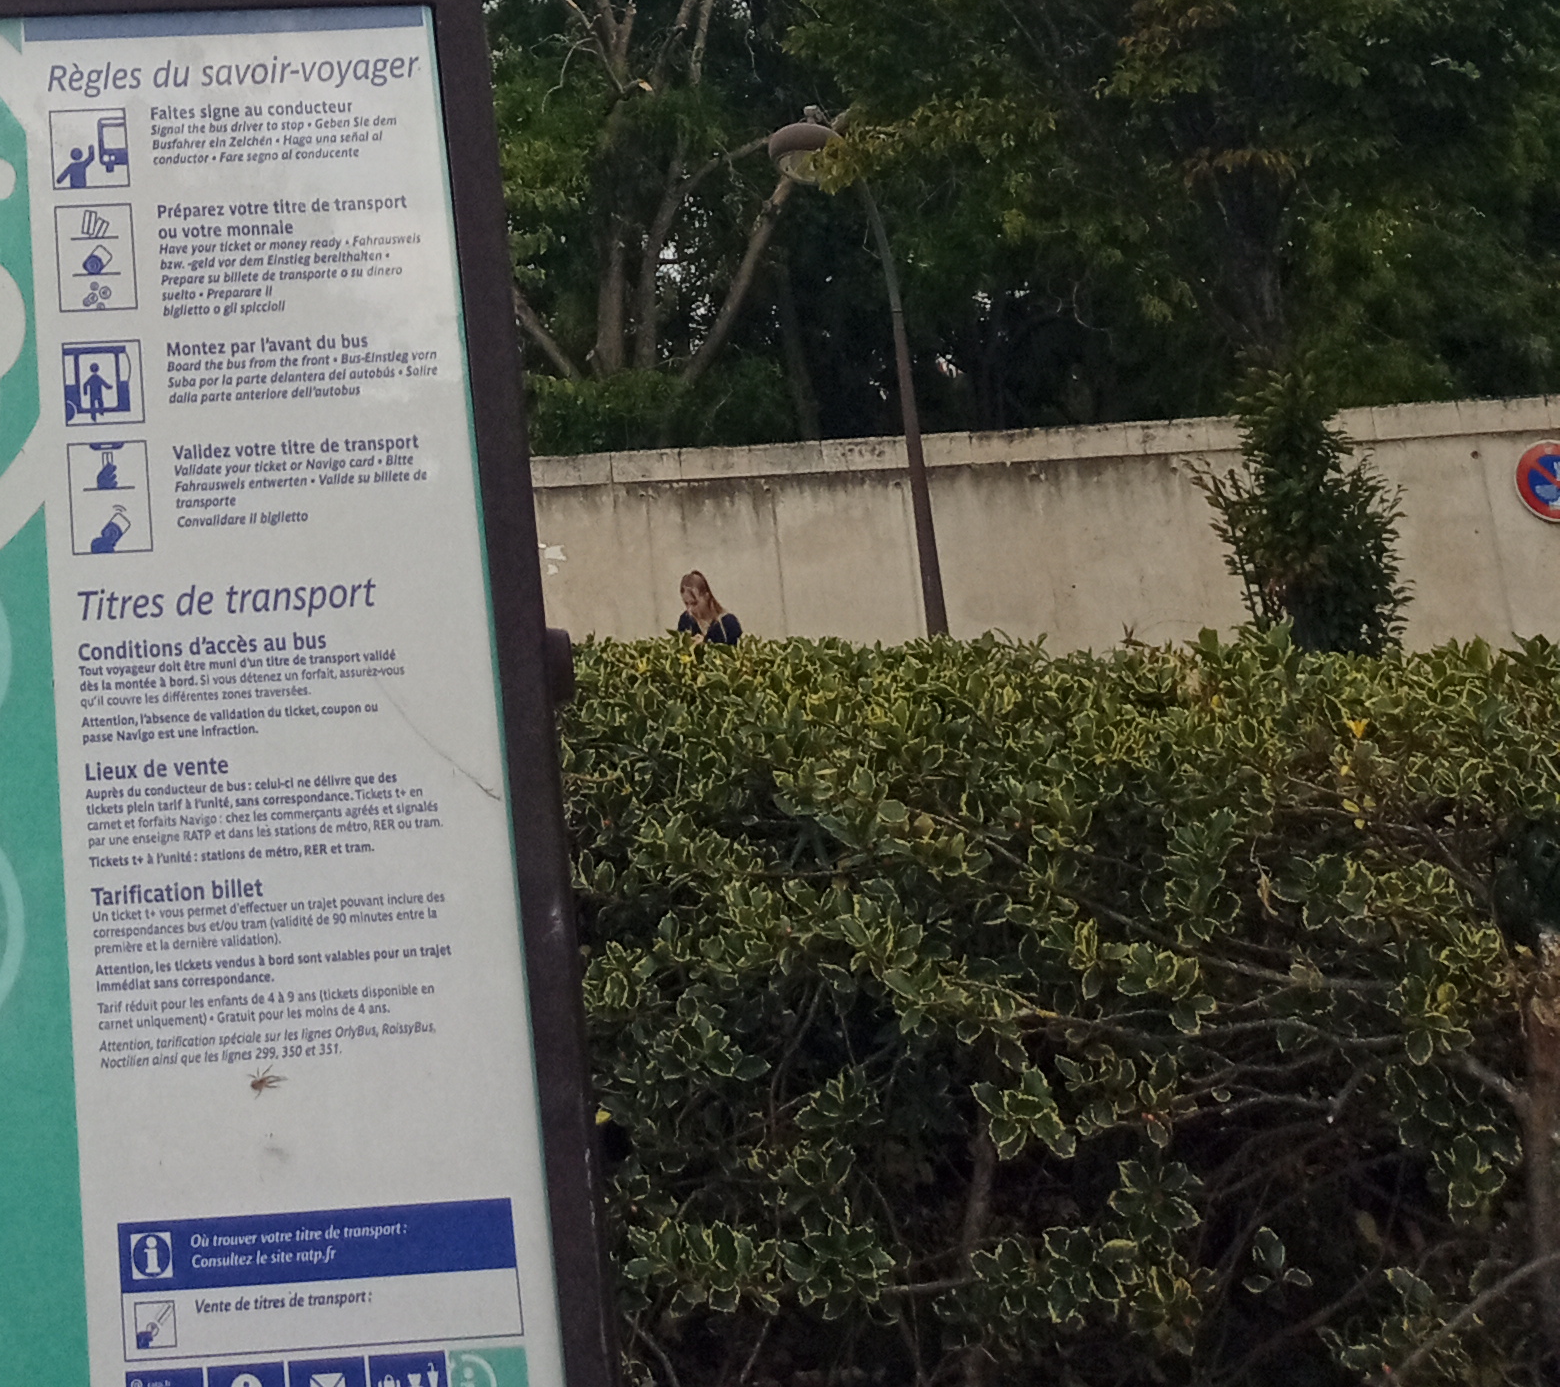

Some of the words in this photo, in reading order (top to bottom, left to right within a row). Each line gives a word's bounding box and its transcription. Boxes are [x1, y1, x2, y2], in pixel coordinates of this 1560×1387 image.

[48, 62, 140, 97] Règles
[153, 59, 189, 88] du
[202, 56, 417, 87] savoir-voyager
[150, 105, 194, 120] Faites
[200, 103, 239, 122] signe
[244, 105, 262, 116] au
[267, 100, 351, 115] conducteur
[157, 203, 223, 220] Préparez
[229, 202, 268, 215] votre
[273, 198, 306, 214] titre
[311, 197, 329, 212] de
[334, 195, 406, 212] transport
[158, 227, 177, 239] ou
[182, 224, 221, 238] votre
[226, 220, 292, 236] monnaie
[166, 341, 225, 356] Montez
[230, 342, 255, 358] par
[316, 334, 335, 349] du
[341, 334, 367, 348] bus
[172, 443, 230, 459] Validez
[235, 442, 275, 457] votre
[281, 439, 314, 455] titre
[319, 437, 339, 453] de
[344, 436, 418, 454] transport
[78, 589, 163, 620] Titres
[176, 584, 213, 616] de
[227, 579, 375, 616] transport
[78, 640, 181, 661] Conditions
[263, 637, 286, 651] au
[293, 632, 326, 650] bus
[78, 665, 103, 676] Tout
[106, 664, 155, 676] voyageur
[158, 660, 180, 672] doit
[183, 659, 205, 671] être
[208, 657, 236, 669] muni
[265, 655, 289, 666] titre
[292, 654, 306, 665] de
[309, 652, 360, 665] transport
[363, 648, 395, 661] validé
[193, 710, 206, 721] de
[209, 707, 264, 720] validation
[267, 706, 281, 717] du
[321, 704, 361, 716] coupon
[364, 703, 378, 712] ou
[82, 733, 113, 745] passe
[116, 728, 154, 742] Navigo
[157, 728, 175, 739] est
[177, 728, 198, 738] une
[85, 762, 136, 781] Lieux
[143, 759, 167, 778] de
[174, 758, 228, 776] vente
[91, 884, 204, 905] Tarification
[212, 880, 262, 899] billet
[92, 910, 108, 922] Un
[111, 909, 141, 921] ticket
[144, 908, 155, 919] t+
[159, 908, 184, 918] vous
[187, 904, 226, 918] permet
[290, 901, 304, 910] un
[307, 897, 337, 911] trajet
[340, 896, 383, 910] pouvant
[387, 893, 423, 904] inclure
[426, 891, 445, 902] des
[155, 960, 171, 972] les
[174, 959, 212, 971] tickets
[215, 956, 255, 968] vendus
[267, 952, 294, 965] bord
[297, 952, 322, 964] sont
[325, 949, 369, 962] valables
[373, 949, 398, 962] pour
[402, 948, 417, 958] un
[419, 944, 452, 958] trajet
[96, 978, 150, 991] immédiat
[153, 978, 178, 988] sans
[190, 1234, 209, 1247] Où
[212, 1234, 256, 1246] trouver
[260, 1231, 292, 1243] votre
[295, 1228, 322, 1241] titre
[324, 1226, 340, 1239] de
[191, 1253, 252, 1268] Consultez
[255, 1251, 267, 1264] le
[270, 1250, 292, 1263] site
[296, 1247, 335, 1263] ratp.fr
[195, 1300, 231, 1313] Vente
[234, 1297, 250, 1311] de
[254, 1296, 285, 1309] titres
[288, 1294, 304, 1307] de
